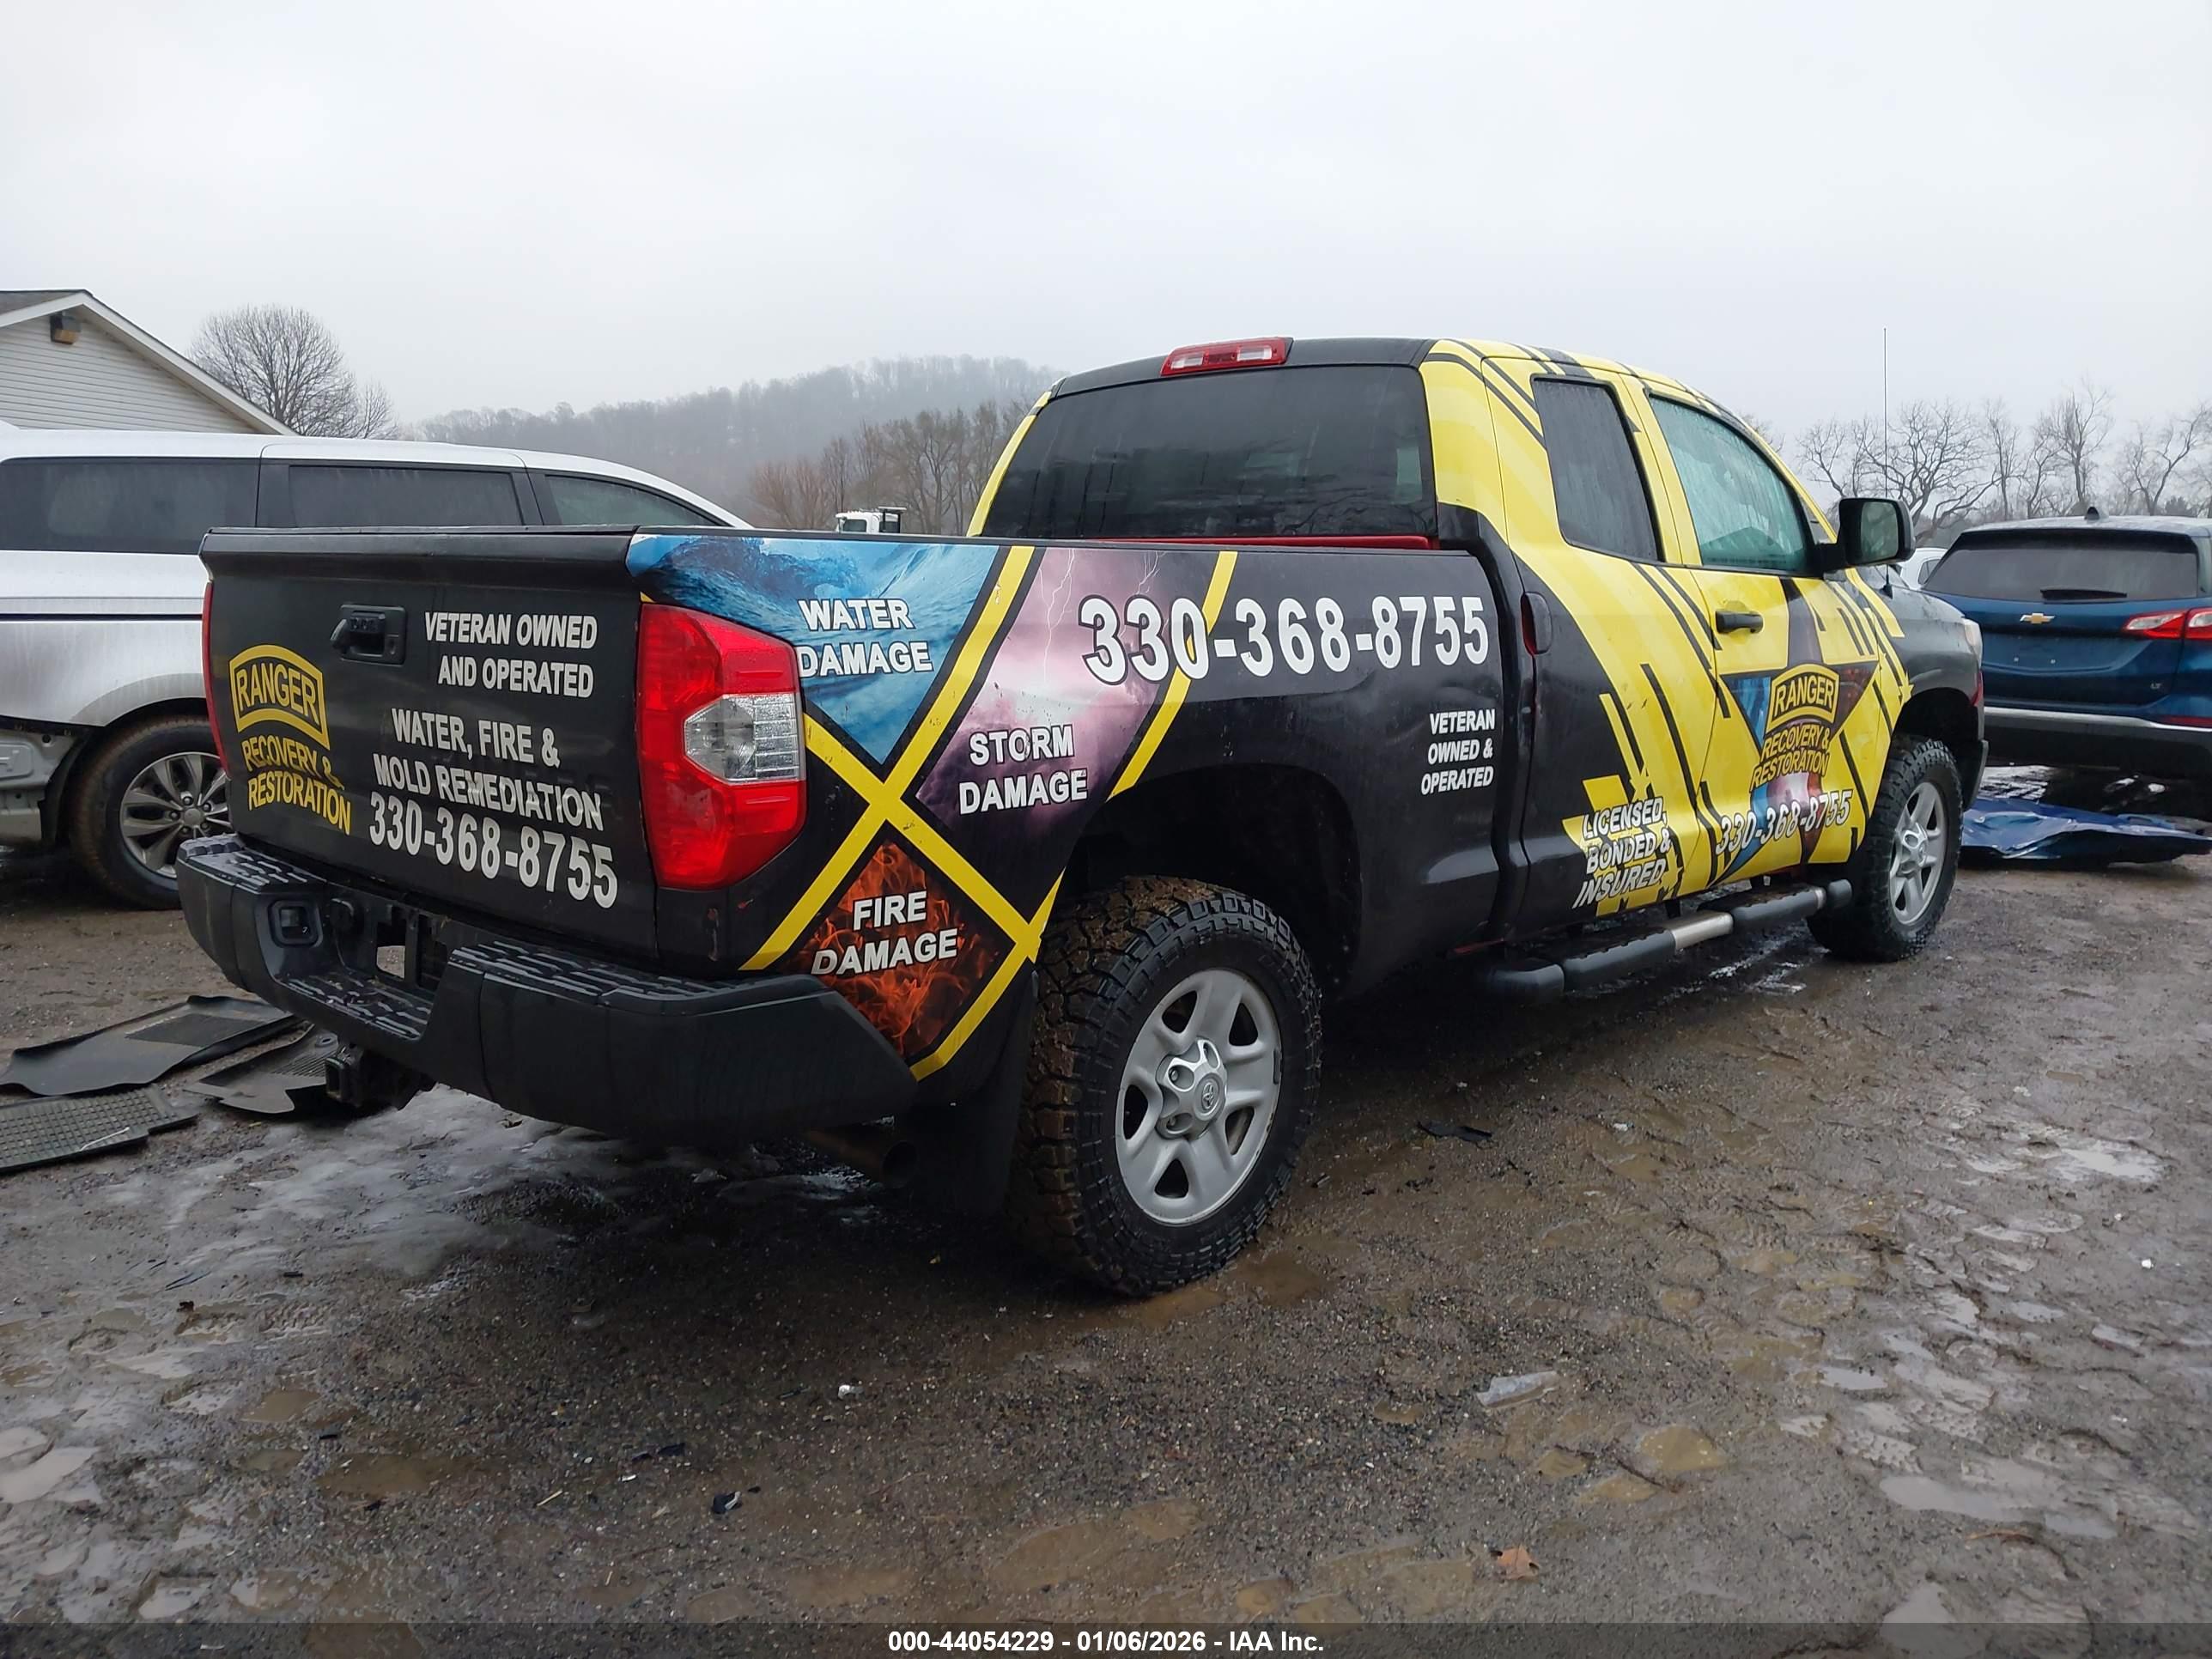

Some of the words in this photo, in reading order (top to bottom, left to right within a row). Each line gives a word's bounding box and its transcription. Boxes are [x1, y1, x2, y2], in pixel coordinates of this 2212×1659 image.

[424, 612, 511, 645] VETERAN
[516, 615, 598, 649] OWNED
[798, 599, 915, 631] WATER
[798, 641, 933, 678] DAMAGE
[1080, 594, 1489, 684] 330-368-8755
[235, 662, 320, 726] RANGER
[438, 655, 477, 686] AND
[482, 659, 593, 697] OPERATED
[1774, 675, 1834, 718] RANGER
[392, 708, 473, 760] WATER,
[478, 720, 535, 763] FIRE
[541, 728, 561, 768] &
[1430, 709, 1495, 735] VETERAN
[240, 735, 321, 779] RECOVERY
[322, 755, 344, 790] &
[969, 725, 1074, 766] STORM
[1428, 740, 1480, 765] OWNED
[1482, 738, 1493, 759] &
[1761, 726, 1821, 762] RECOVERY
[1822, 727, 1830, 750] &
[373, 754, 430, 795] MOLD
[435, 770, 605, 831] REMEDIATION
[958, 768, 1088, 815] DAMAGE
[1421, 767, 1494, 795] OPERATED
[1750, 750, 1831, 793] RESTORATION
[248, 771, 350, 836] RESTORATION
[1583, 796, 1667, 839] LICENSED,
[1716, 790, 1853, 854] 330-368-8755
[369, 793, 618, 909] 330-368-8755
[1587, 832, 1657, 875] BONDED
[1660, 828, 1672, 854] &
[1572, 859, 1667, 909] INSURED
[852, 890, 927, 931] FIRE
[811, 928, 958, 975] DAMAGE
